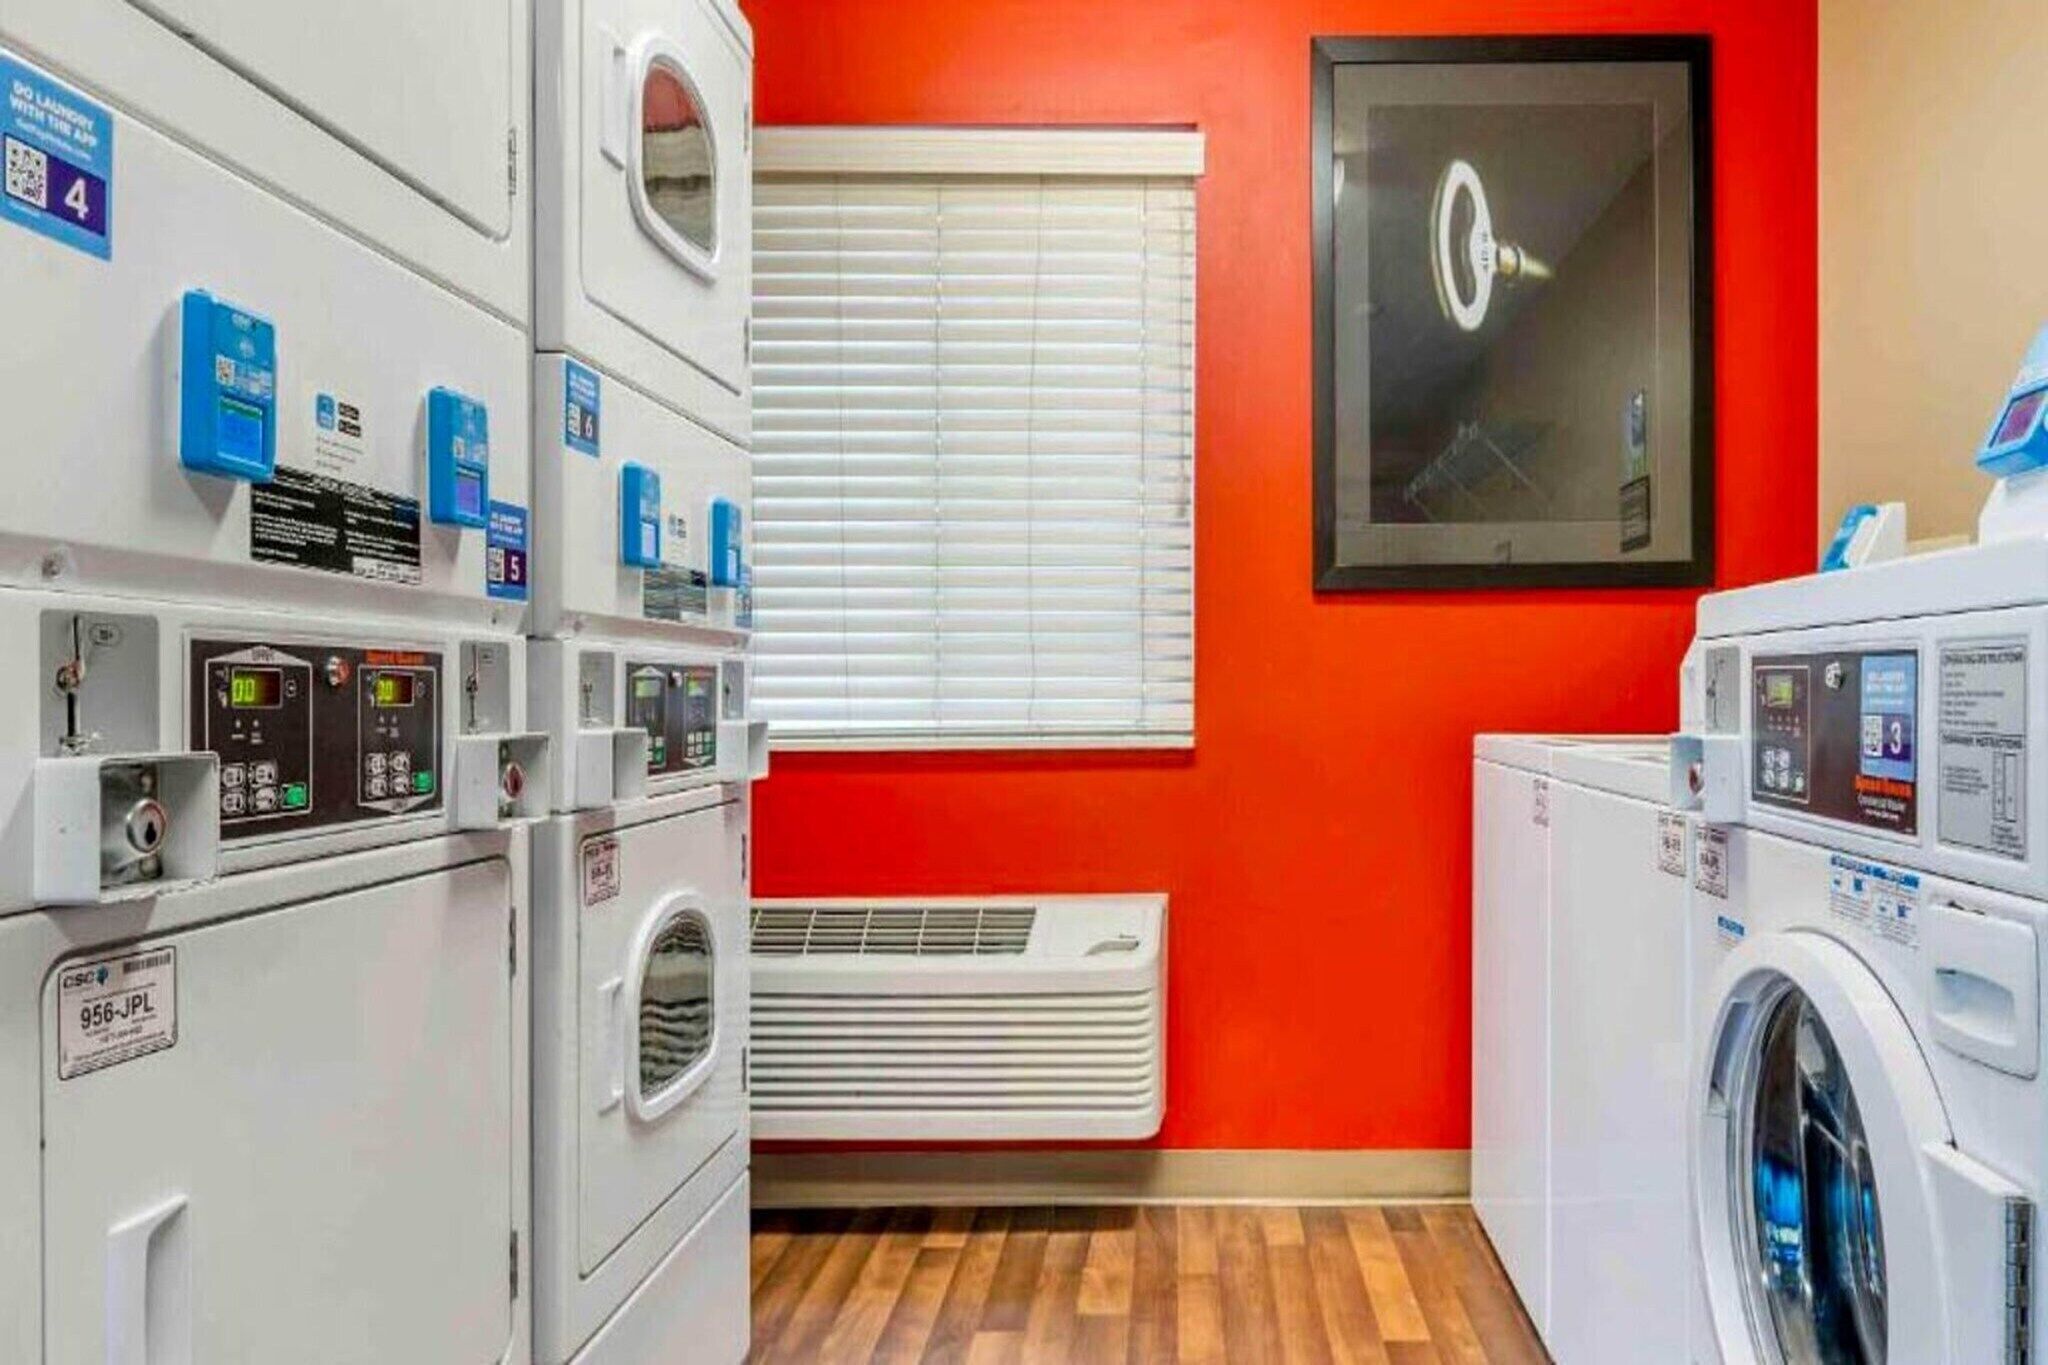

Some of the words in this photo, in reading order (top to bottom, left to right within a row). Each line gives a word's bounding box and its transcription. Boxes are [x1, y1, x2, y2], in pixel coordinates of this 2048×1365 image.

[10, 92, 45, 124] WITH
[73, 128, 97, 147] APP
[13, 80, 33, 100] DO
[36, 92, 94, 131] LAUNDRY
[64, 178, 89, 220] 4
[585, 415, 593, 438] 6
[511, 555, 520, 581] 5
[1890, 721, 1901, 754] 3
[63, 971, 95, 989] CSC
[81, 991, 155, 1030] 956-JPL
